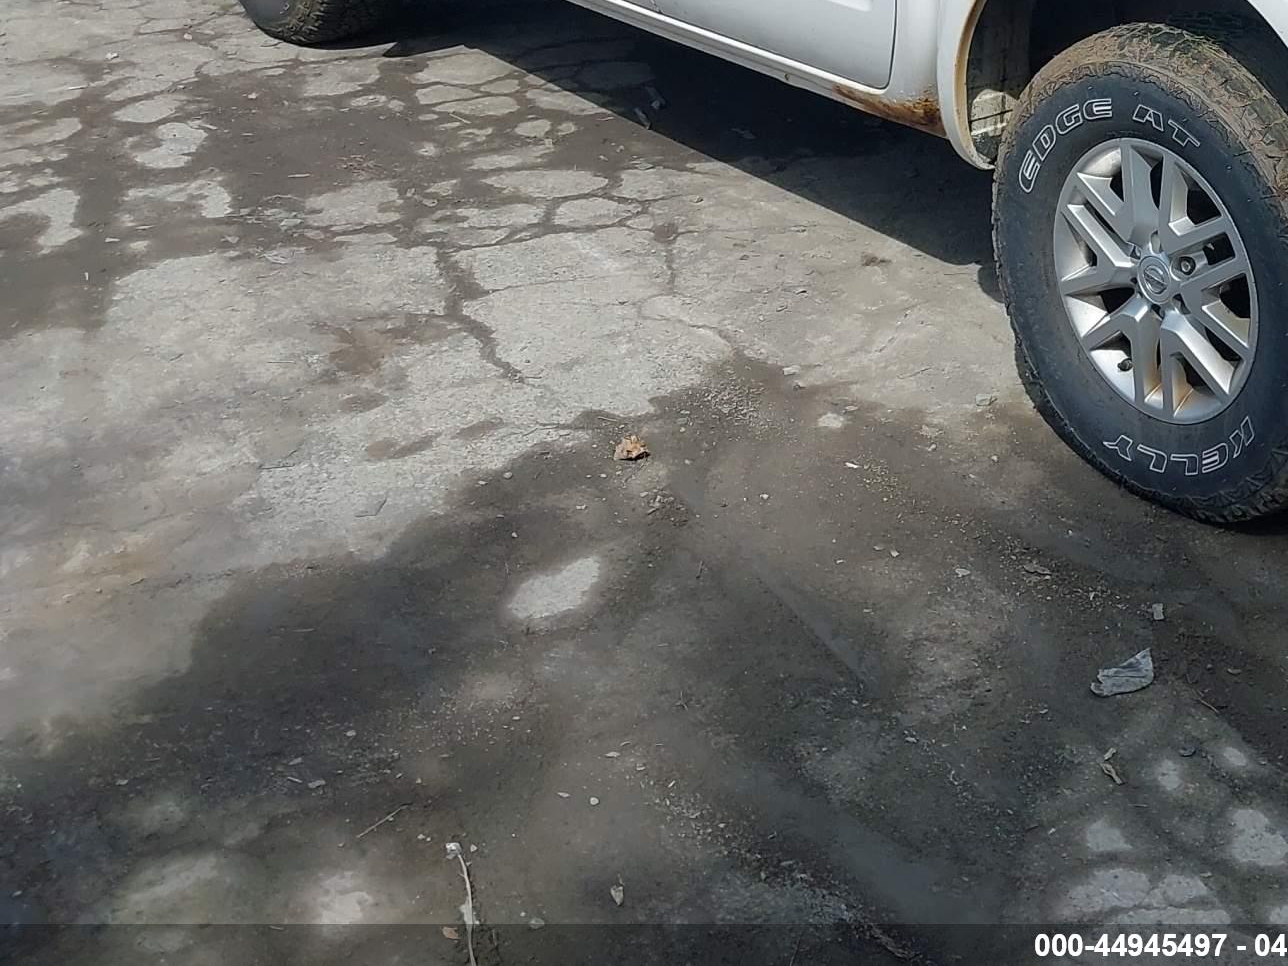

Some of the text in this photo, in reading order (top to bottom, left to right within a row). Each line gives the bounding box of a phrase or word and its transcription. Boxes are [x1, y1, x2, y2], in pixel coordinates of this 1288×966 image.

[1019, 98, 1201, 193] EDGE AT
[1103, 415, 1255, 476] KELLY
